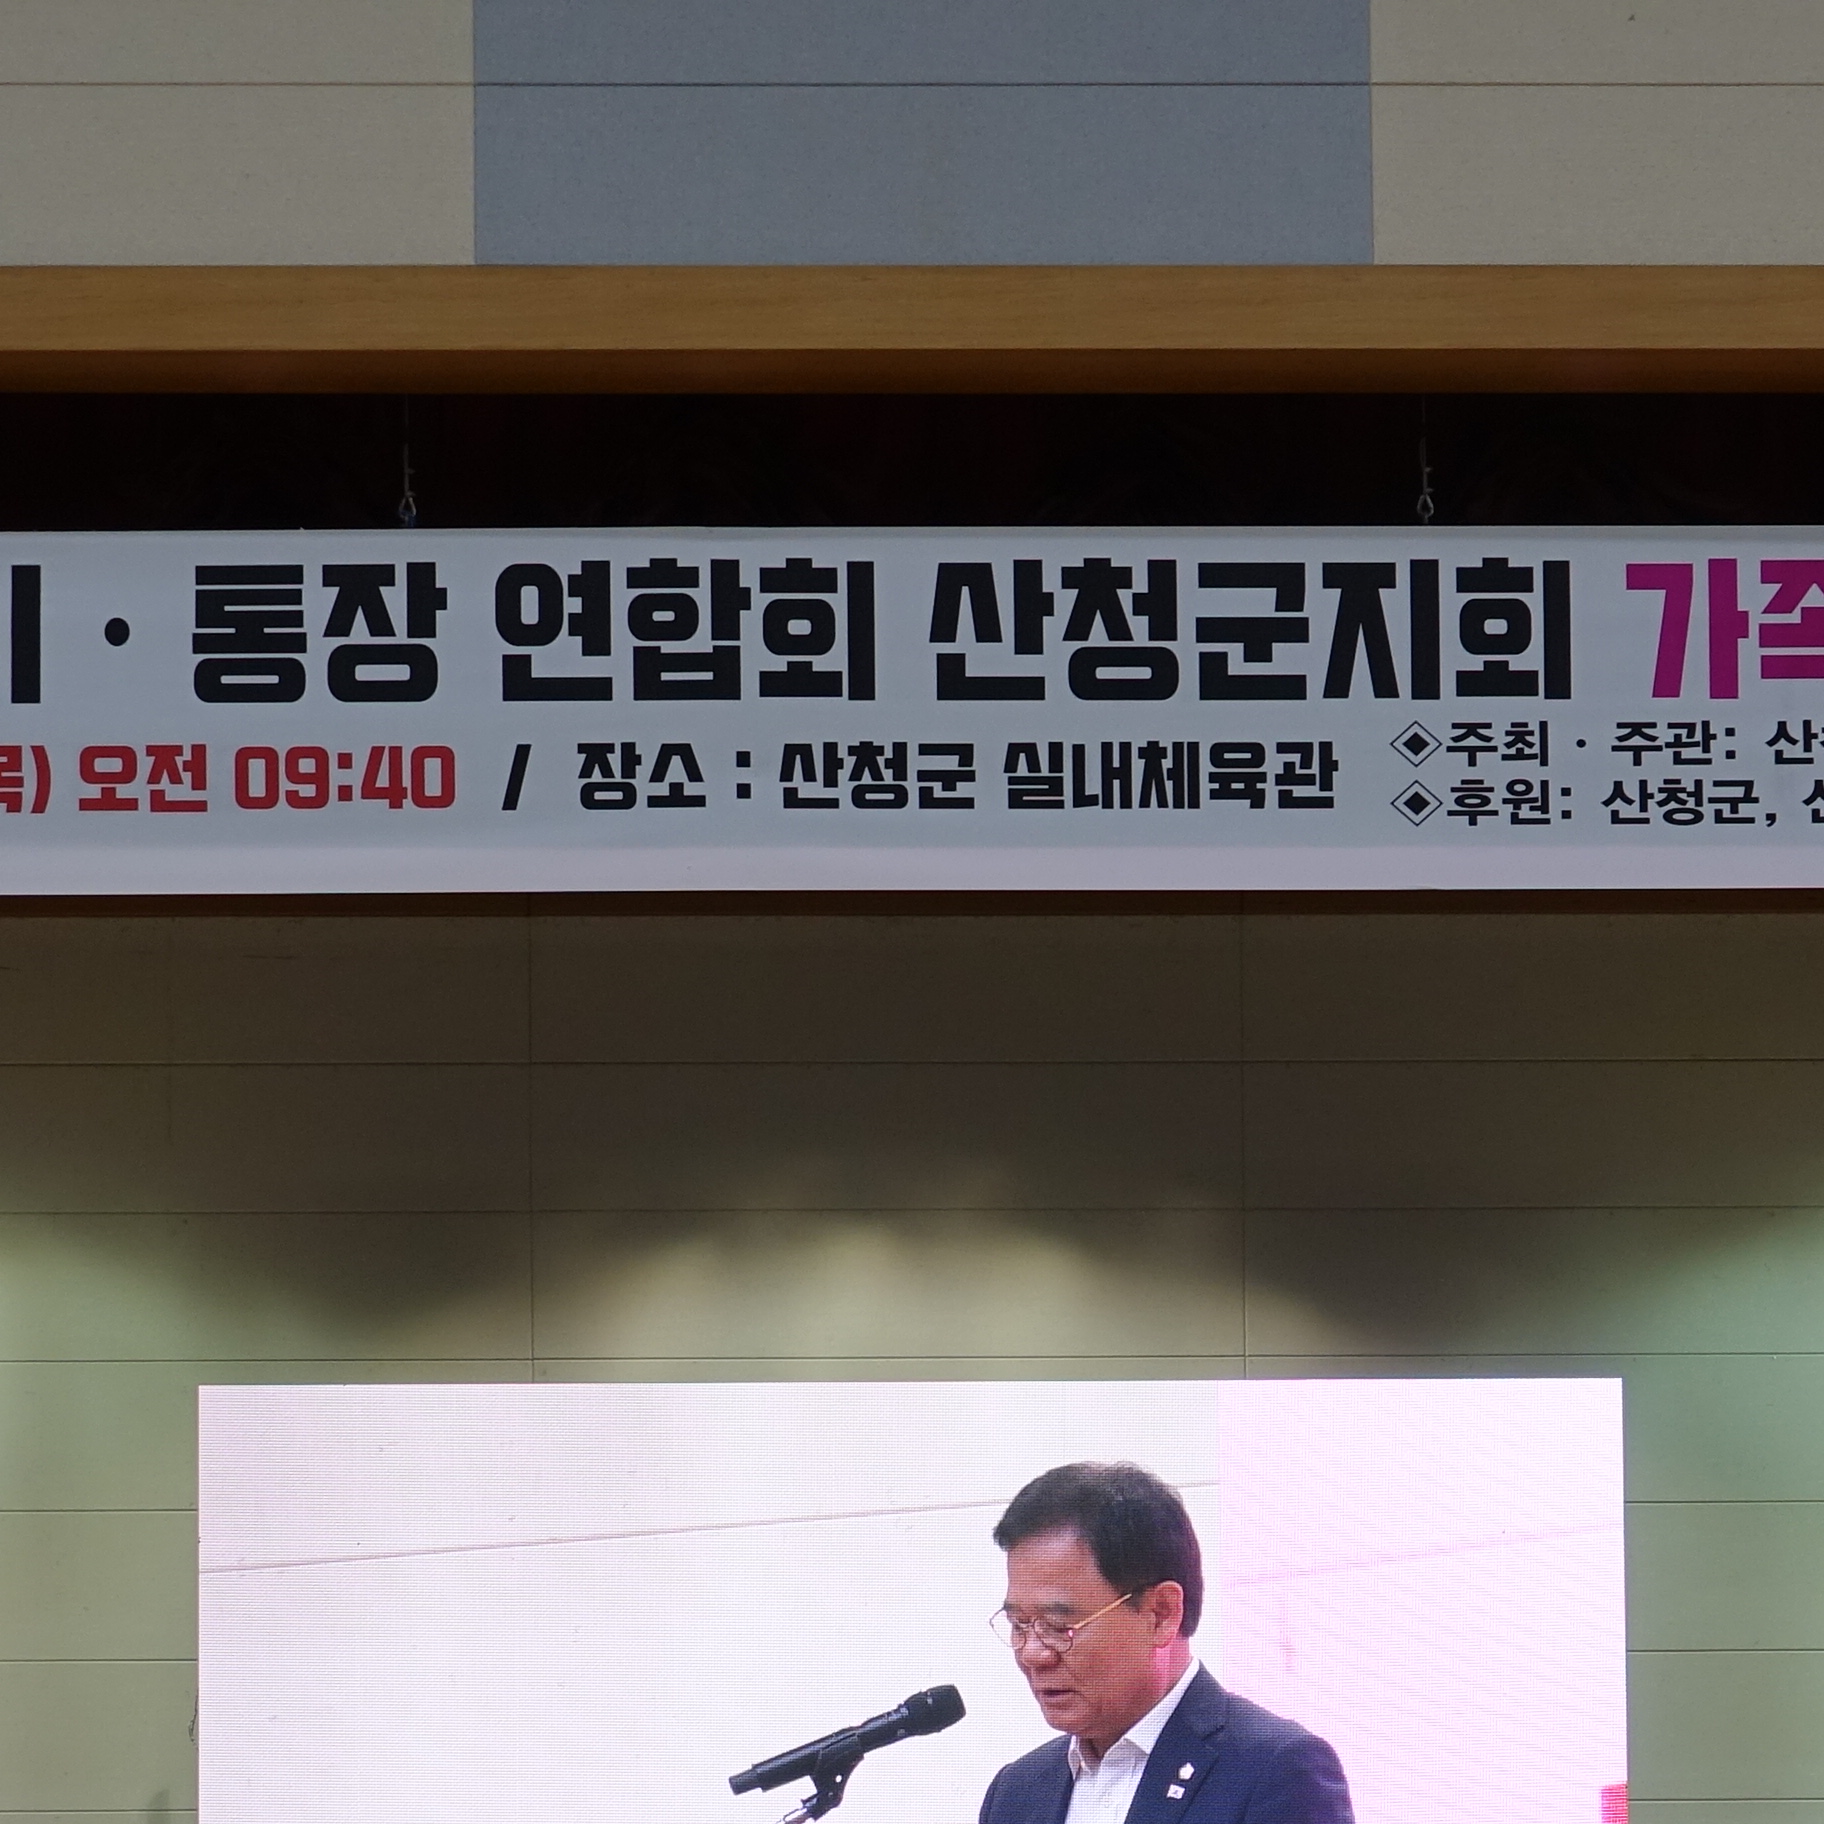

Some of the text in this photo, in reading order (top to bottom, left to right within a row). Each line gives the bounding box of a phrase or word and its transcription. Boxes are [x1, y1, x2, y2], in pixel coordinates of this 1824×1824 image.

[192, 562, 447, 703] 통장
[495, 558, 875, 702] 연합회
[929, 557, 1571, 701] 산청군지회
[1446, 721, 1549, 767] 주최
[1610, 720, 1736, 767] 주관:
[79, 744, 208, 813] 오전
[235, 745, 455, 810] 09:40
[577, 742, 706, 811] 장소
[779, 741, 976, 810] 산청군
[1004, 741, 1338, 810] 실내체육관
[1447, 779, 1572, 827] 후원:
[1601, 778, 1777, 828] 산청군,
